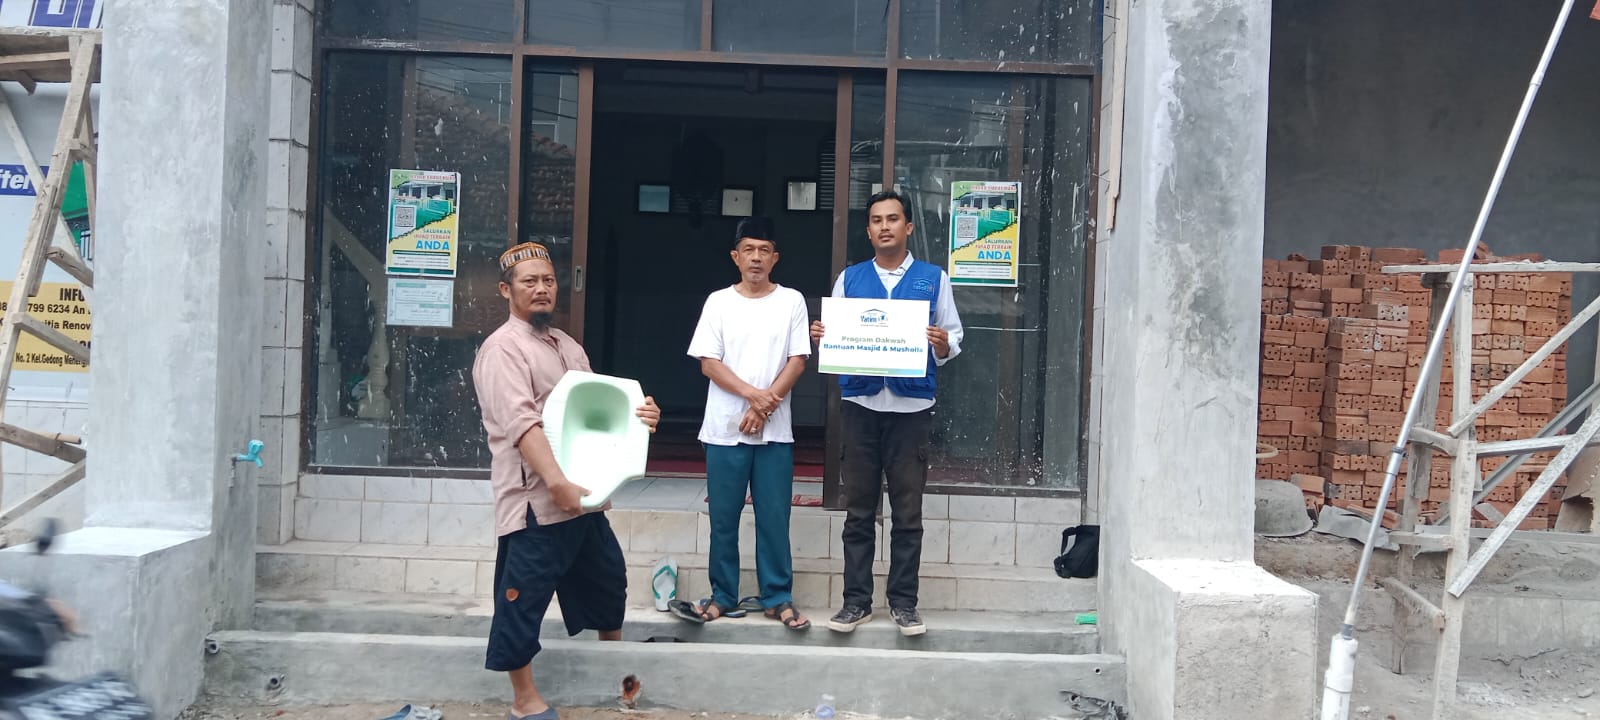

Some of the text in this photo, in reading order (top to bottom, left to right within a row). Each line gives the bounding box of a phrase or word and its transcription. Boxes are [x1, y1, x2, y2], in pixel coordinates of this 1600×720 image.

[416, 240, 450, 250] ANDA
[978, 250, 1011, 260] ANDA
[47, 304, 70, 313] 6234
[73, 305, 85, 314] An
[860, 315, 877, 323] Yatim
[62, 321, 91, 330] Renov
[841, 335, 874, 343] Program
[823, 343, 855, 351] Bantuan
[856, 345, 881, 353] Masjid
[15, 353, 25, 362] No.
[26, 353, 30, 363] 2
